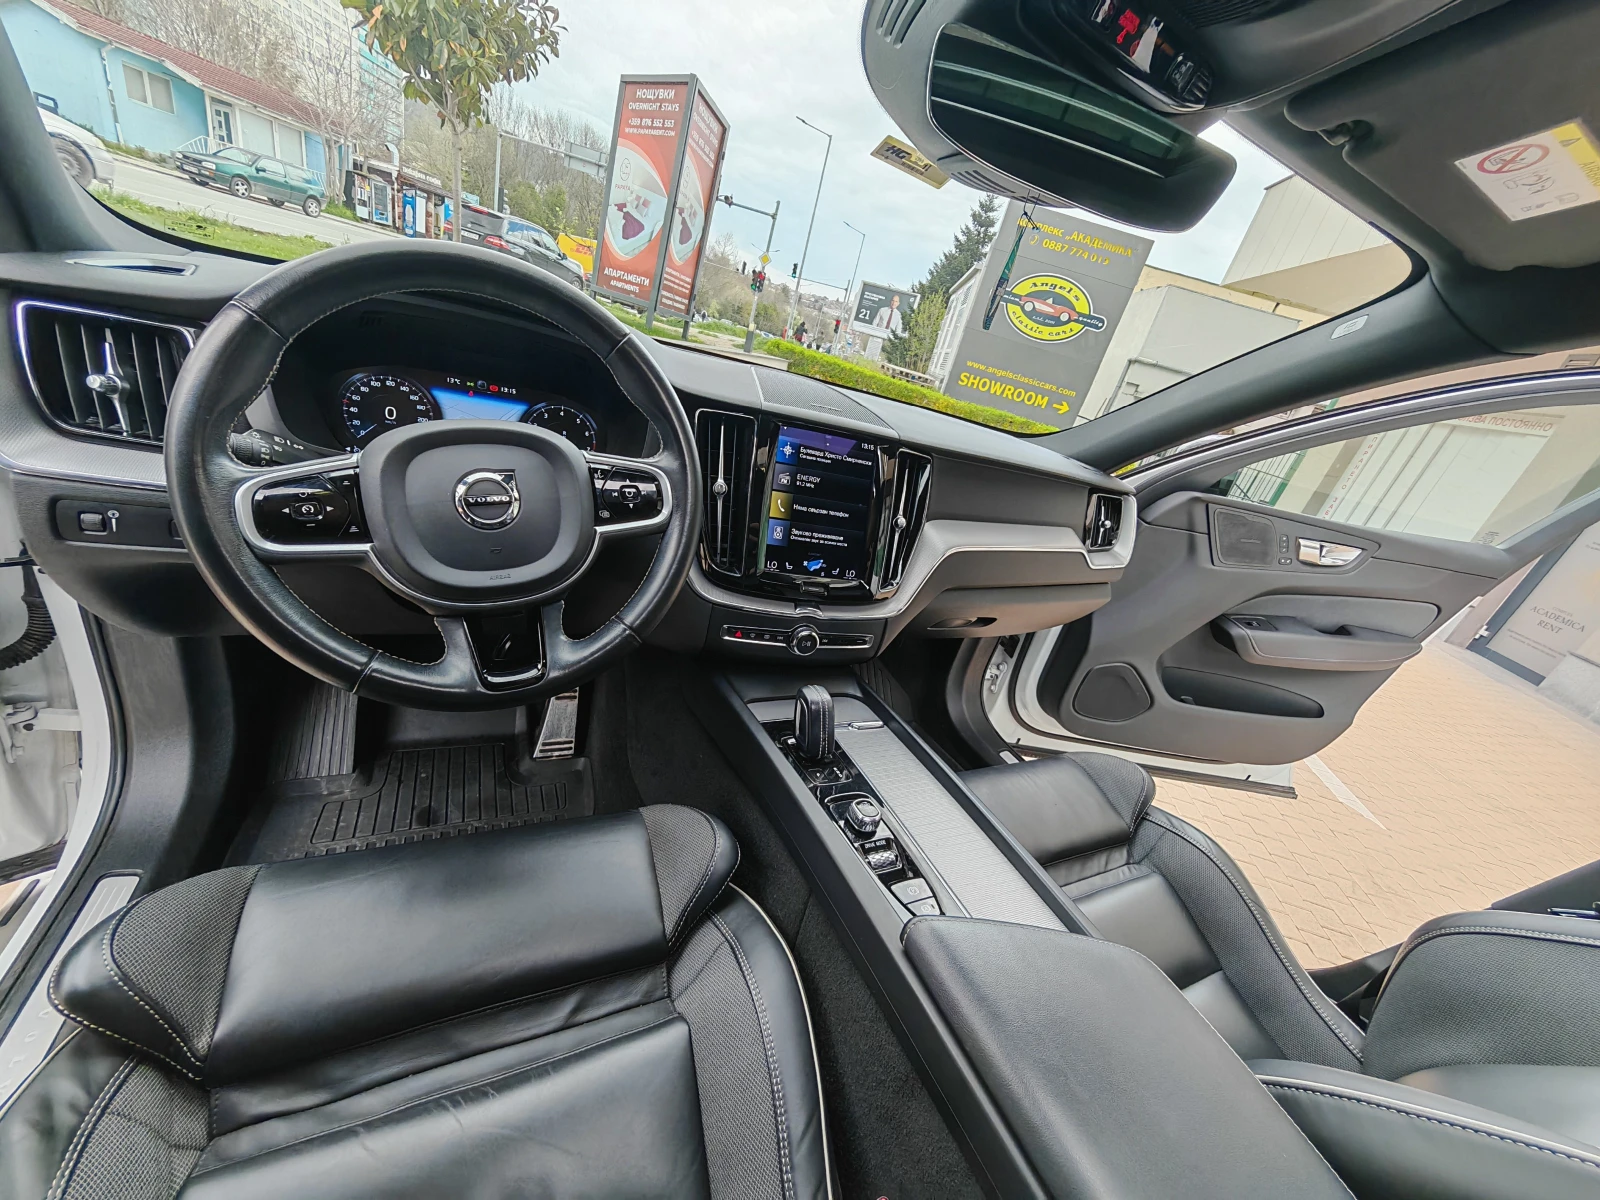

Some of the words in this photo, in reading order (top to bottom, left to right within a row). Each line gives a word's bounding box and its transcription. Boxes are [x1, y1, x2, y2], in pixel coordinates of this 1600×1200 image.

[636, 89, 675, 100] НОЩУВКИ
[628, 102, 660, 111] OVERNIGHT
[661, 103, 679, 112] STAYS
[628, 118, 640, 126] +359
[641, 118, 652, 127] 876
[653, 119, 663, 128] 552
[664, 119, 675, 128] 553
[614, 183, 631, 191] PAPAYA
[1042, 238, 1068, 253] 0887
[1070, 246, 1089, 260] 774
[604, 267, 650, 287] АПАРТАМЕНТИ
[610, 280, 640, 293] APARTMENTS
[859, 308, 871, 320] 21
[1012, 310, 1044, 335] classic
[1047, 327, 1074, 337] cars
[966, 360, 1077, 397] www.angelsclassiccars.com
[501, 386, 517, 394] 13:15
[958, 372, 1049, 409] SHOWROOM
[384, 406, 397, 420] 0
[1488, 416, 1554, 432] ПОСТОЯННО
[861, 443, 875, 451] 13:15
[824, 451, 842, 460] Христо
[1341, 433, 1379, 490] ПИРАНЕТО
[796, 473, 821, 483] ENERGY
[766, 560, 778, 569] LO
[845, 569, 856, 578] LO
[1530, 606, 1586, 632] ACADEMICA
[1537, 620, 1563, 634] RENT
